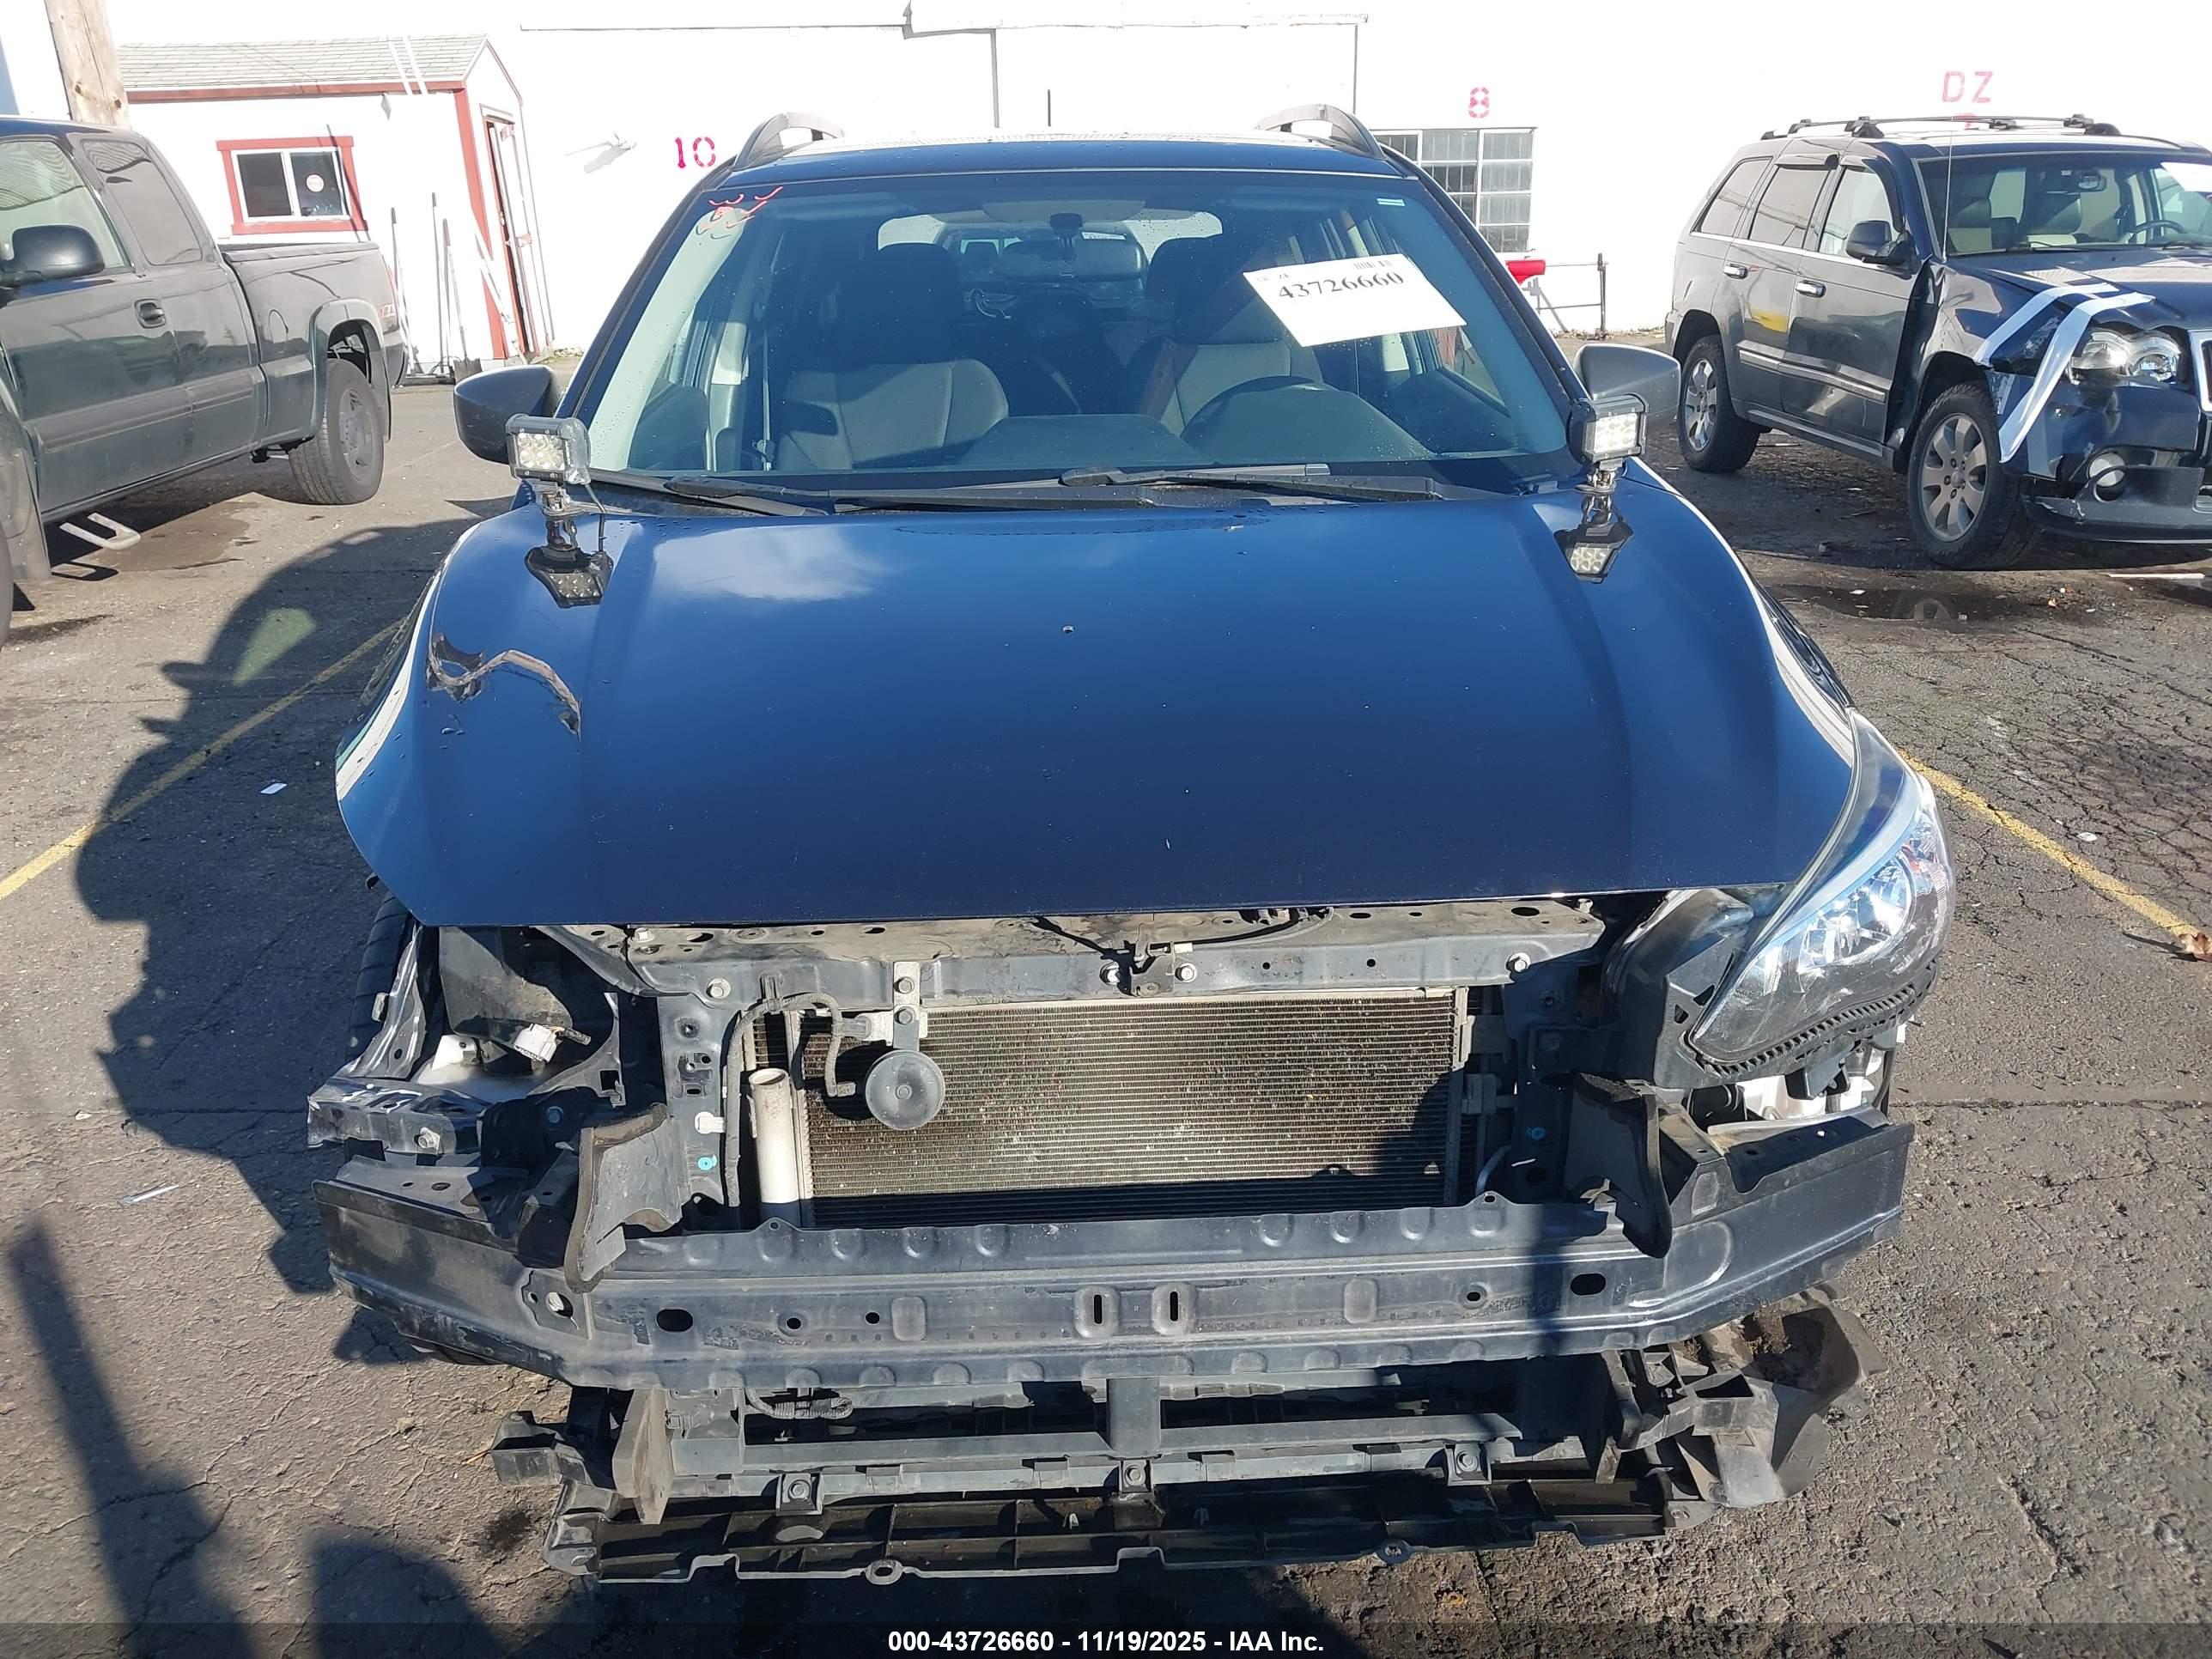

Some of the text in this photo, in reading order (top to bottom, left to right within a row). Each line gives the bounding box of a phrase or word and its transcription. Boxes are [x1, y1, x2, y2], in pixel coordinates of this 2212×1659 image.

[1468, 87, 1490, 118] 8
[675, 137, 716, 168] 10
[1279, 271, 1404, 298] 43726660
